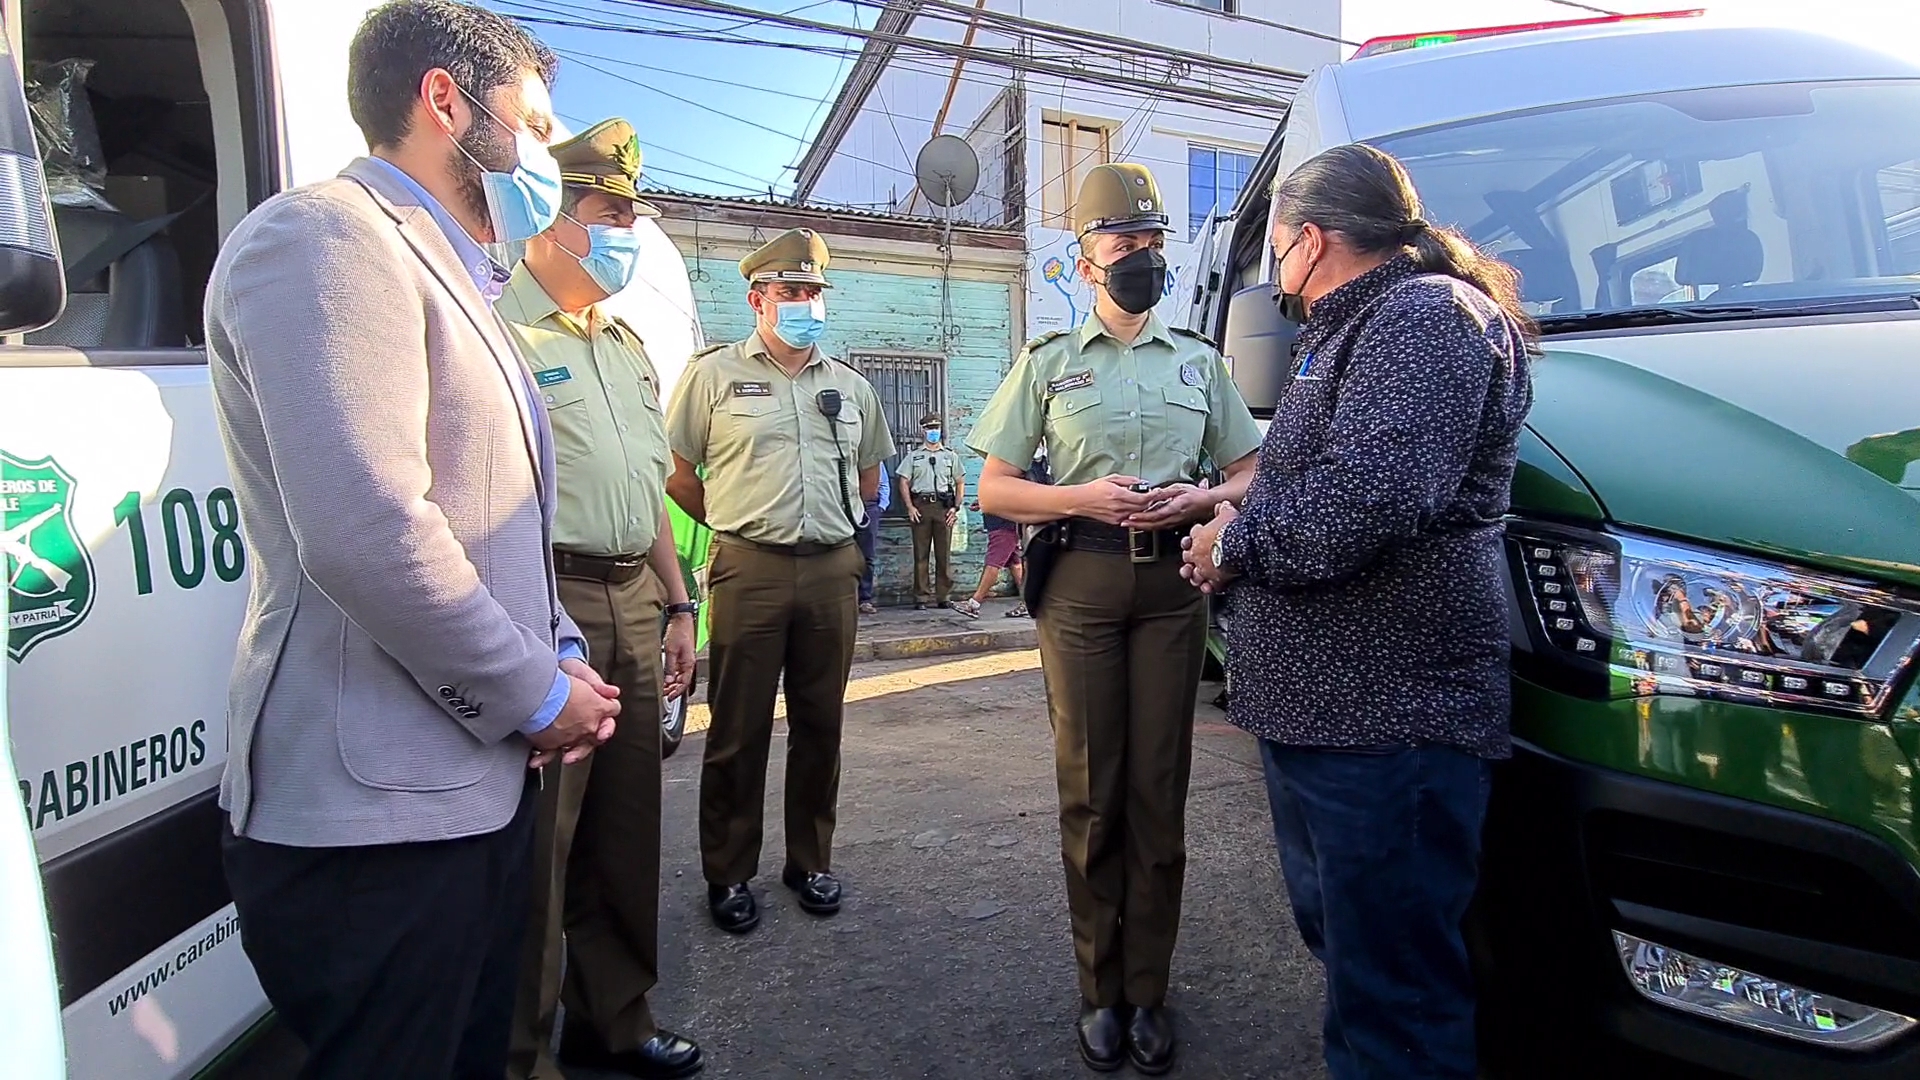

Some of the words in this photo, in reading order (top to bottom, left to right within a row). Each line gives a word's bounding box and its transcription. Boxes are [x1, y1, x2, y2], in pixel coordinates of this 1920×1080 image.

[38, 479, 58, 493] DE
[113, 487, 245, 595] 108
[12, 614, 20, 624] Y
[22, 610, 58, 623] PATRIA
[108, 916, 240, 1016] www.carabin
